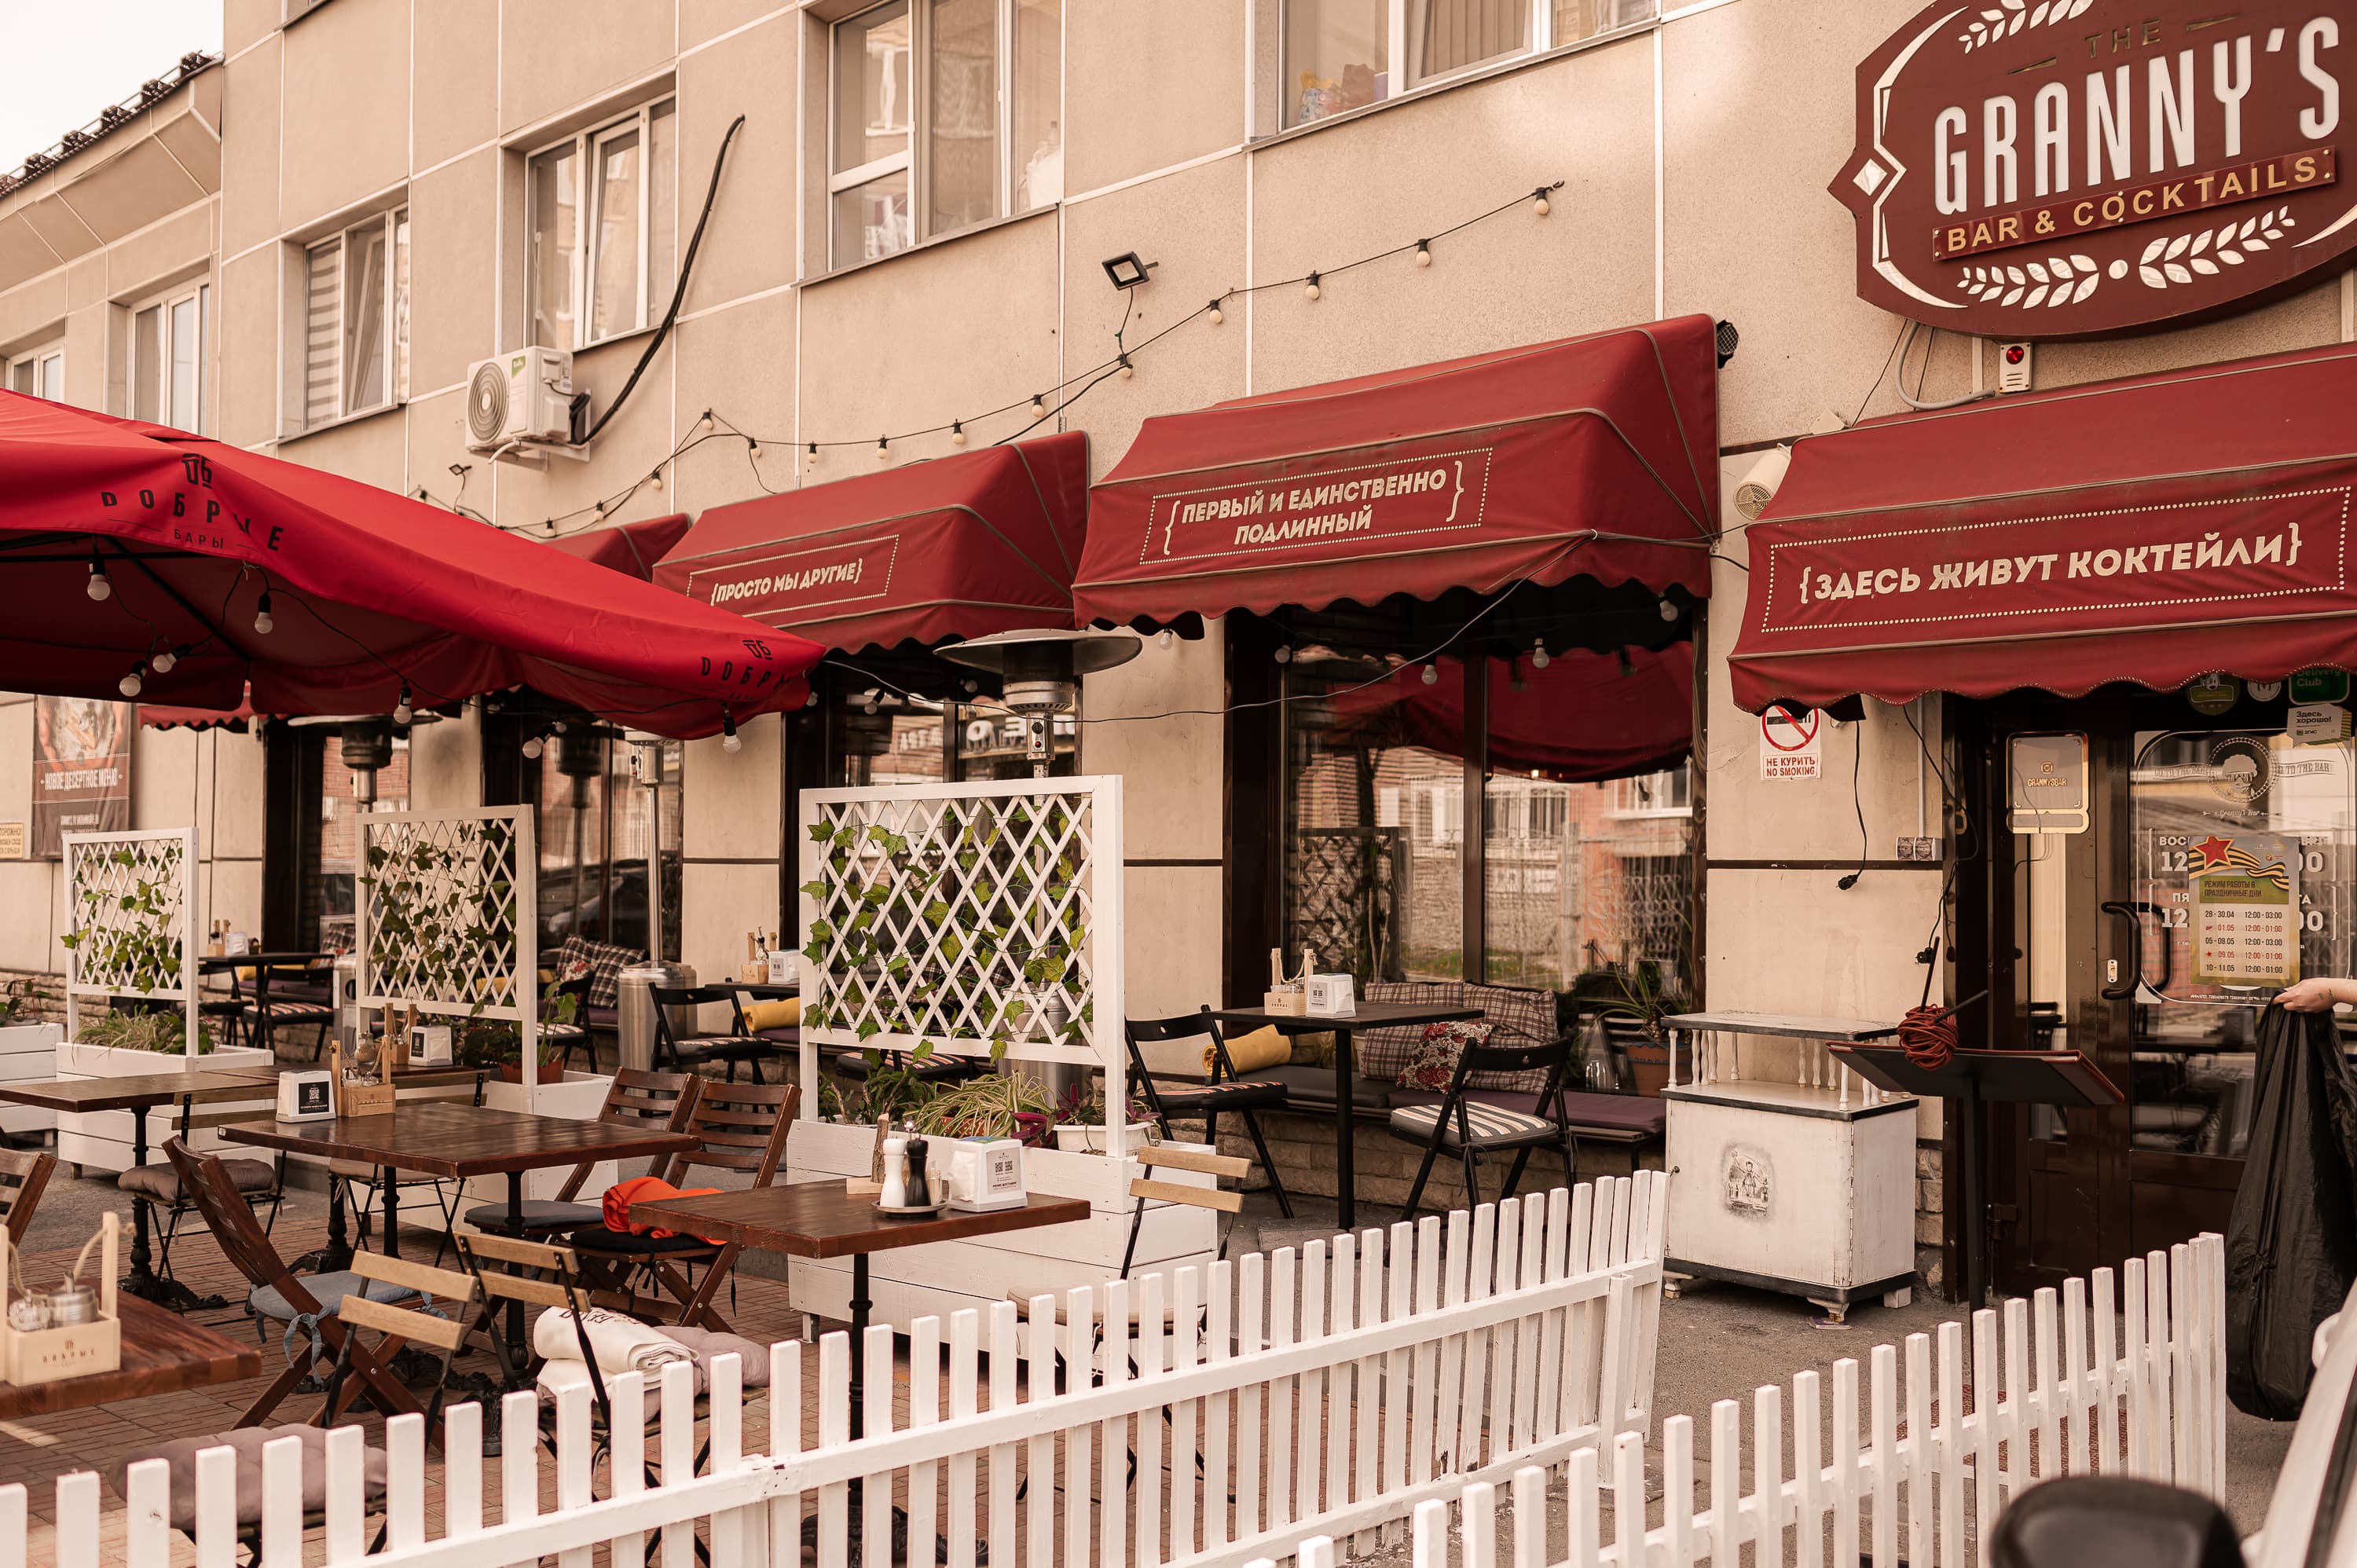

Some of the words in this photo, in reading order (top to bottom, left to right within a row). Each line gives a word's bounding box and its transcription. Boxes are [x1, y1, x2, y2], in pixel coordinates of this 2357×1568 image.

[2084, 19, 2161, 59] THE
[1934, 16, 2340, 215] GRANNY'S
[1947, 215, 2019, 252] BAR
[2034, 209, 2056, 235] &
[2073, 156, 2318, 227] COCKTAILS
[1267, 494, 1284, 511] И
[1288, 469, 1447, 511] ЕДИНСТВЕННО
[1233, 504, 1373, 545] ПОДЛИННЫЙ
[174, 528, 224, 549] БАРЫ
[1928, 554, 2058, 591] ЖИВУТ
[772, 572, 800, 593] МЫ
[2297, 677, 2322, 687] Club
[2296, 716, 2332, 724] хорошо!
[1765, 757, 1779, 767] НЕ
[1780, 756, 1816, 767] КУРИТЬ
[1766, 767, 1778, 777] NO
[1780, 766, 1816, 777] SMOKING
[2159, 836, 2190, 846] ВОС
[2204, 880, 2226, 888] РЕЖИМ
[2227, 880, 2250, 888] РАБОТЫ
[2172, 892, 2190, 903] ПЯ
[2204, 888, 2248, 898] ПРАЗДНИЧНЫЕ
[2249, 889, 2262, 899] ДНИ
